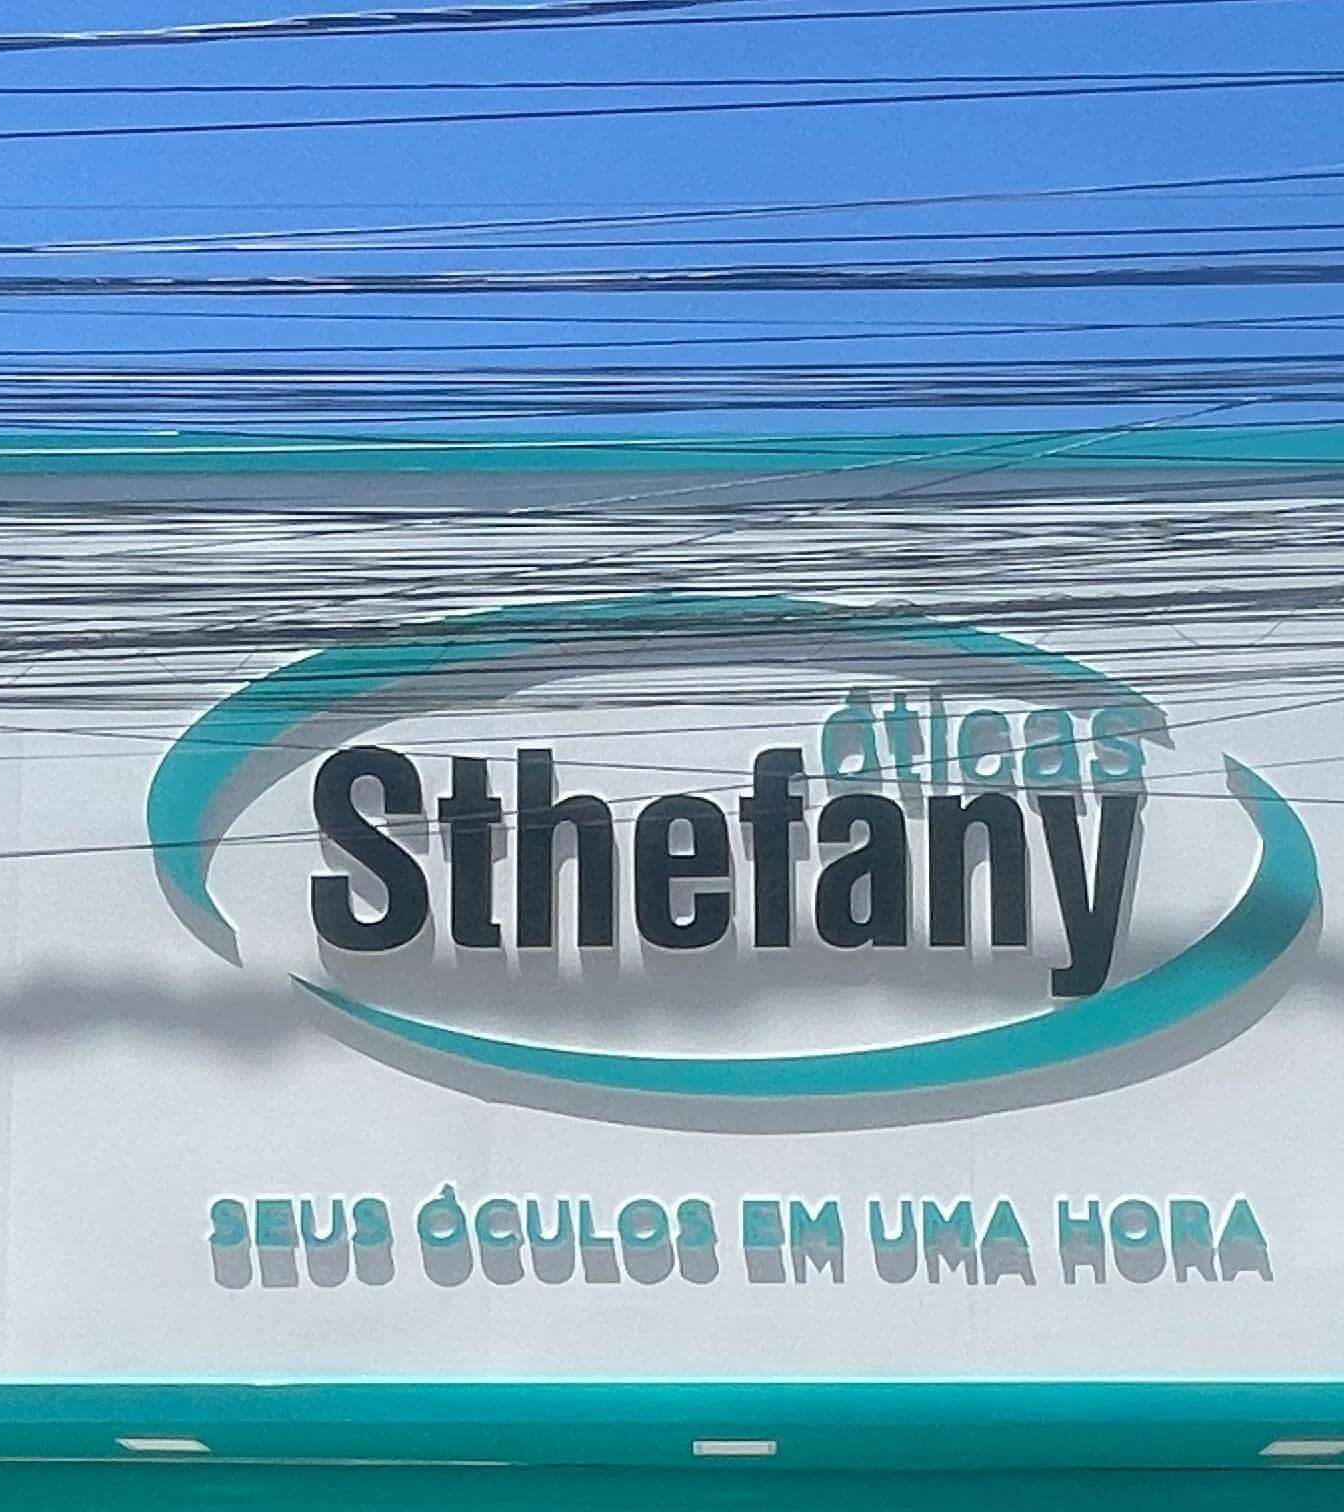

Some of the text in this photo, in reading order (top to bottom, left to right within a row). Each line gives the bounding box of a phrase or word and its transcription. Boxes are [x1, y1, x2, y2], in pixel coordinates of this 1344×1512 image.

[821, 686, 1146, 786] óticas
[309, 745, 1147, 998] Sthefany
[207, 1182, 1272, 1250] SEUS ÓCULOS EM UMA HORA
